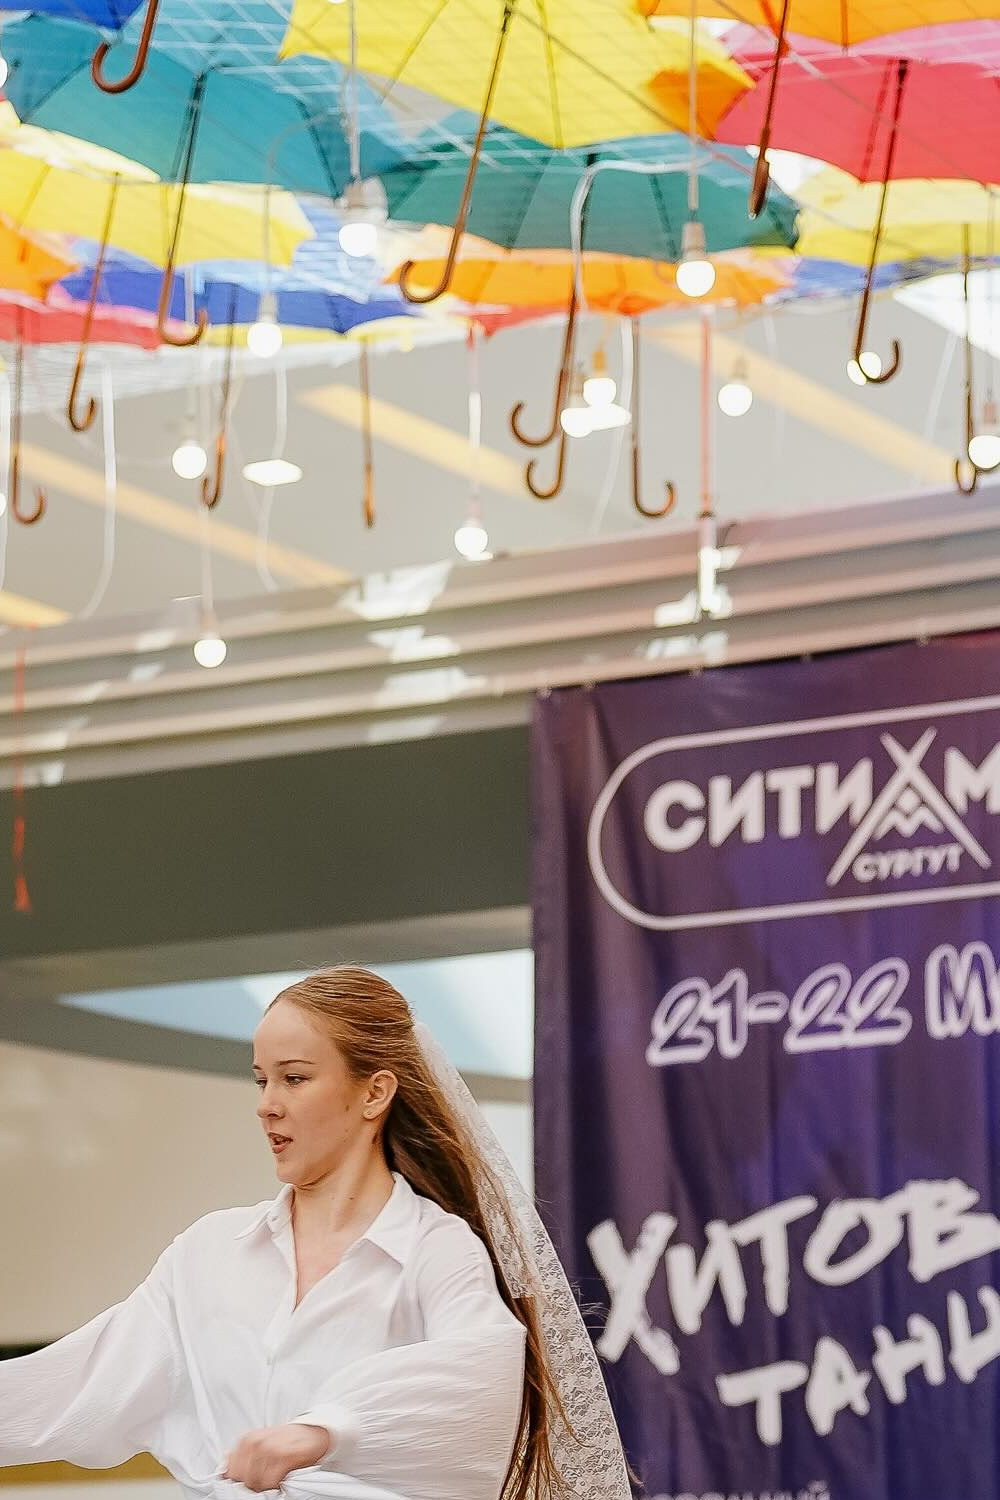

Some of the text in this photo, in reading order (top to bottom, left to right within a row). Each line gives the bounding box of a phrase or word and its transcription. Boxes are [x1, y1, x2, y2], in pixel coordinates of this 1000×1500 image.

[644, 757, 874, 853] СИТИ
[852, 843, 963, 882] СУРГУТ
[645, 954, 913, 1068] 21-22
[586, 1177, 1000, 1376] ХИТОВ
